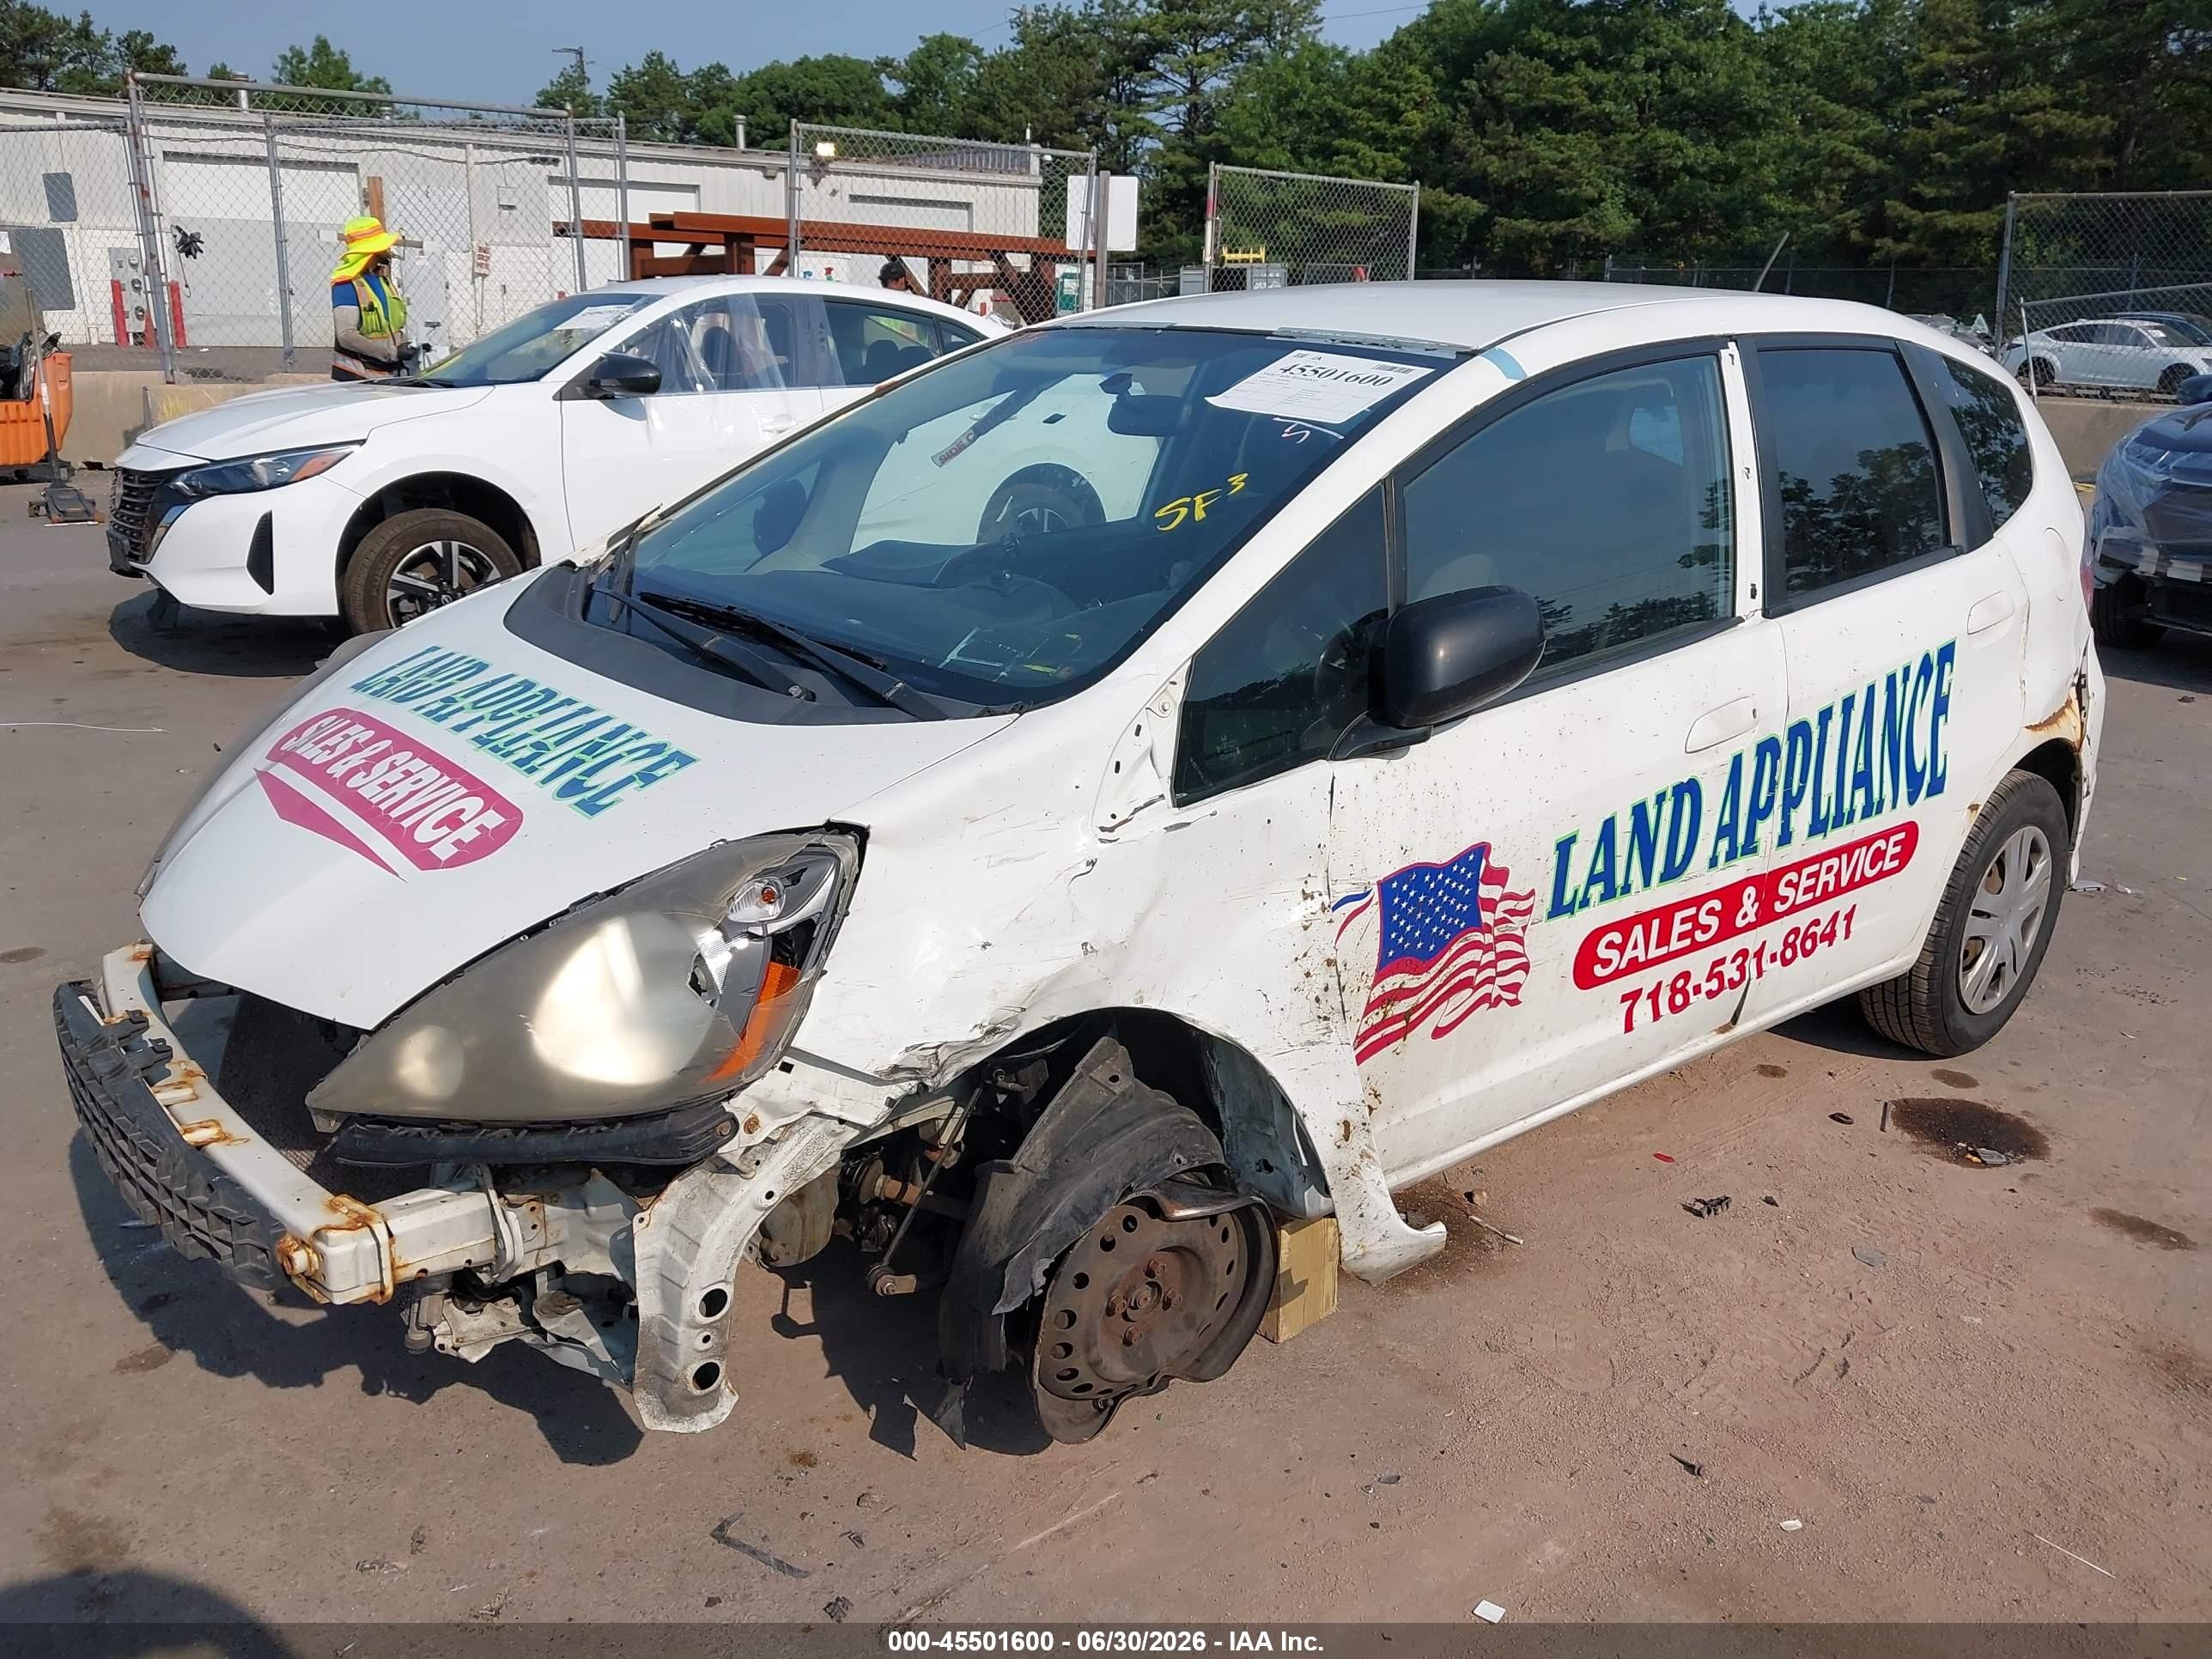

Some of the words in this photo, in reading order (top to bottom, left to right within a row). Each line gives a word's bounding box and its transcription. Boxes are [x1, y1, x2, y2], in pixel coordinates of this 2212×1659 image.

[1279, 363, 1395, 387] 45501600
[938, 440, 966, 465] SIDE
[349, 645, 491, 705] LAND
[280, 714, 375, 765] SALES
[325, 739, 392, 779] &
[410, 672, 700, 819] APPLIANCE
[1545, 775, 1703, 922] LAND
[1707, 637, 1957, 871] APPLIANCE
[345, 750, 507, 862] SERVICE
[1593, 898, 1723, 978] SALES
[1735, 885, 1759, 928] &
[1773, 830, 1907, 914] SERVICE
[1619, 902, 1858, 1035] 718-531-8641
